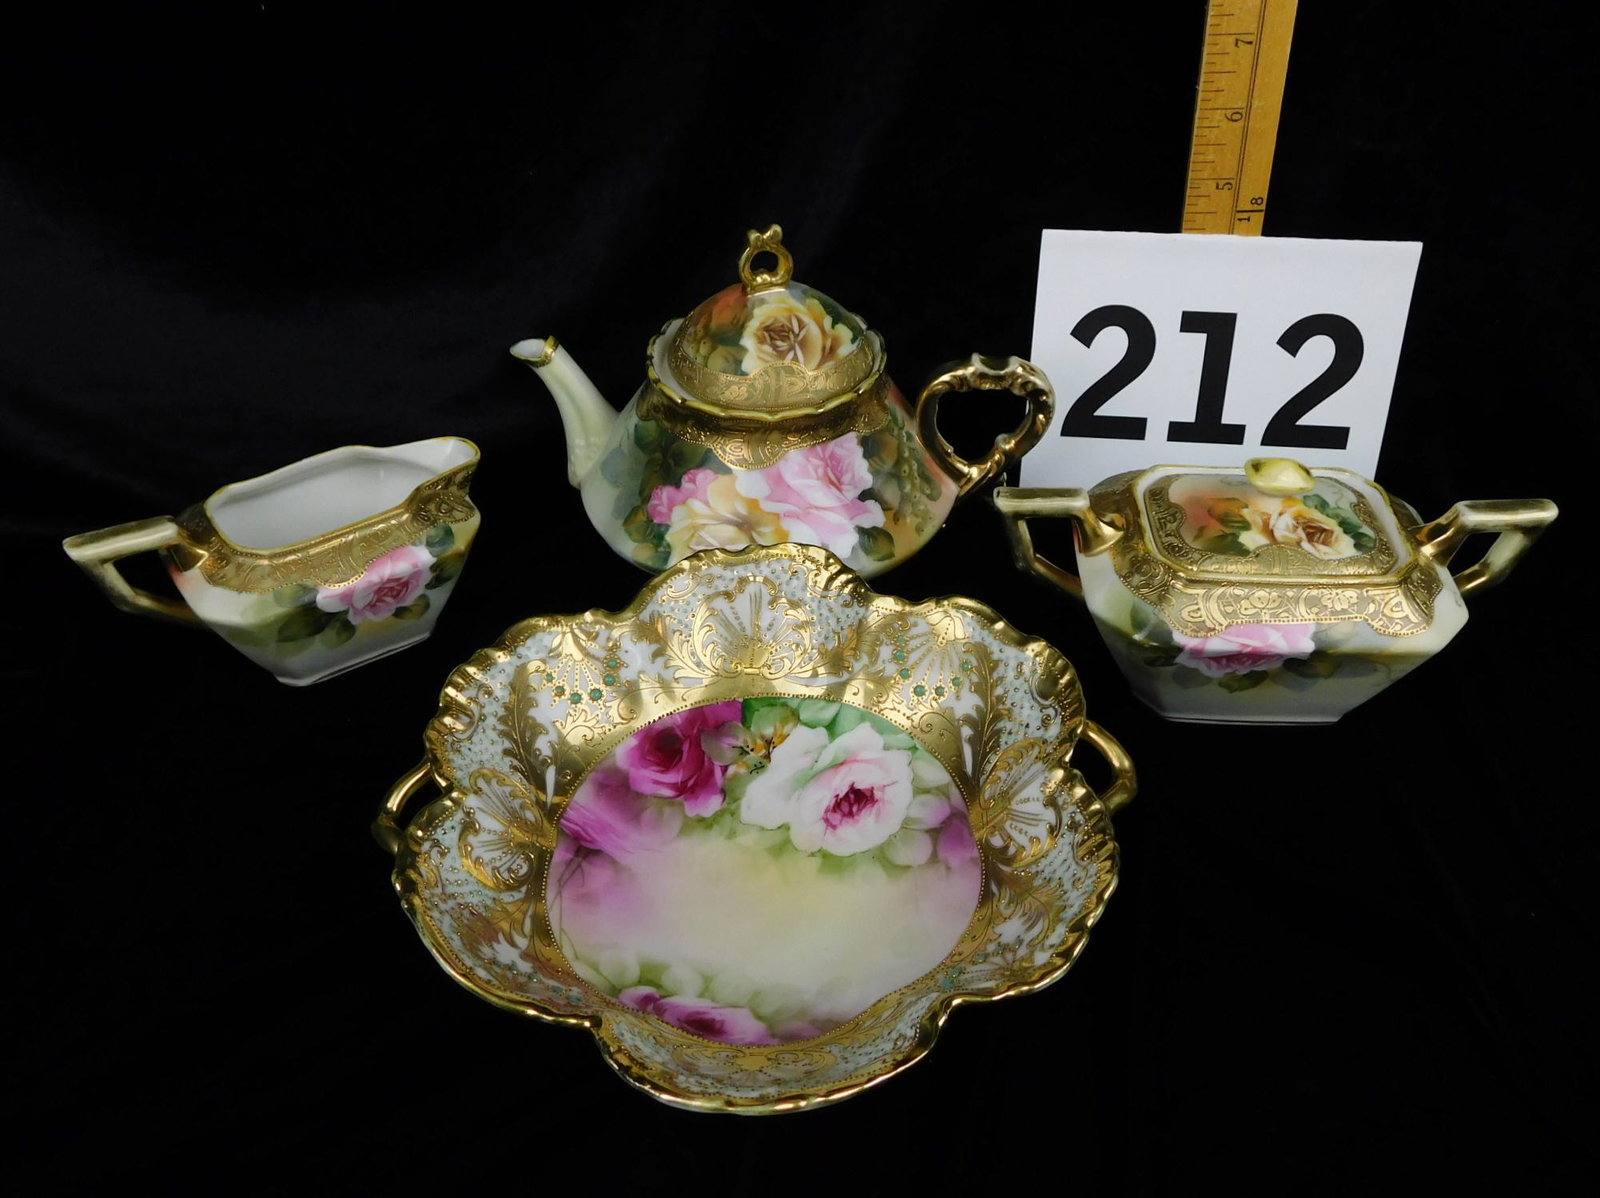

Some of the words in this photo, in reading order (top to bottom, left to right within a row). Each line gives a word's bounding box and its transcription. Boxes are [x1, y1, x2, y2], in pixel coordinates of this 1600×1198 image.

[1234, 38, 1254, 48] 7
[1224, 111, 1244, 123] 6
[1216, 182, 1233, 191] 5
[1060, 304, 1364, 450] 212
